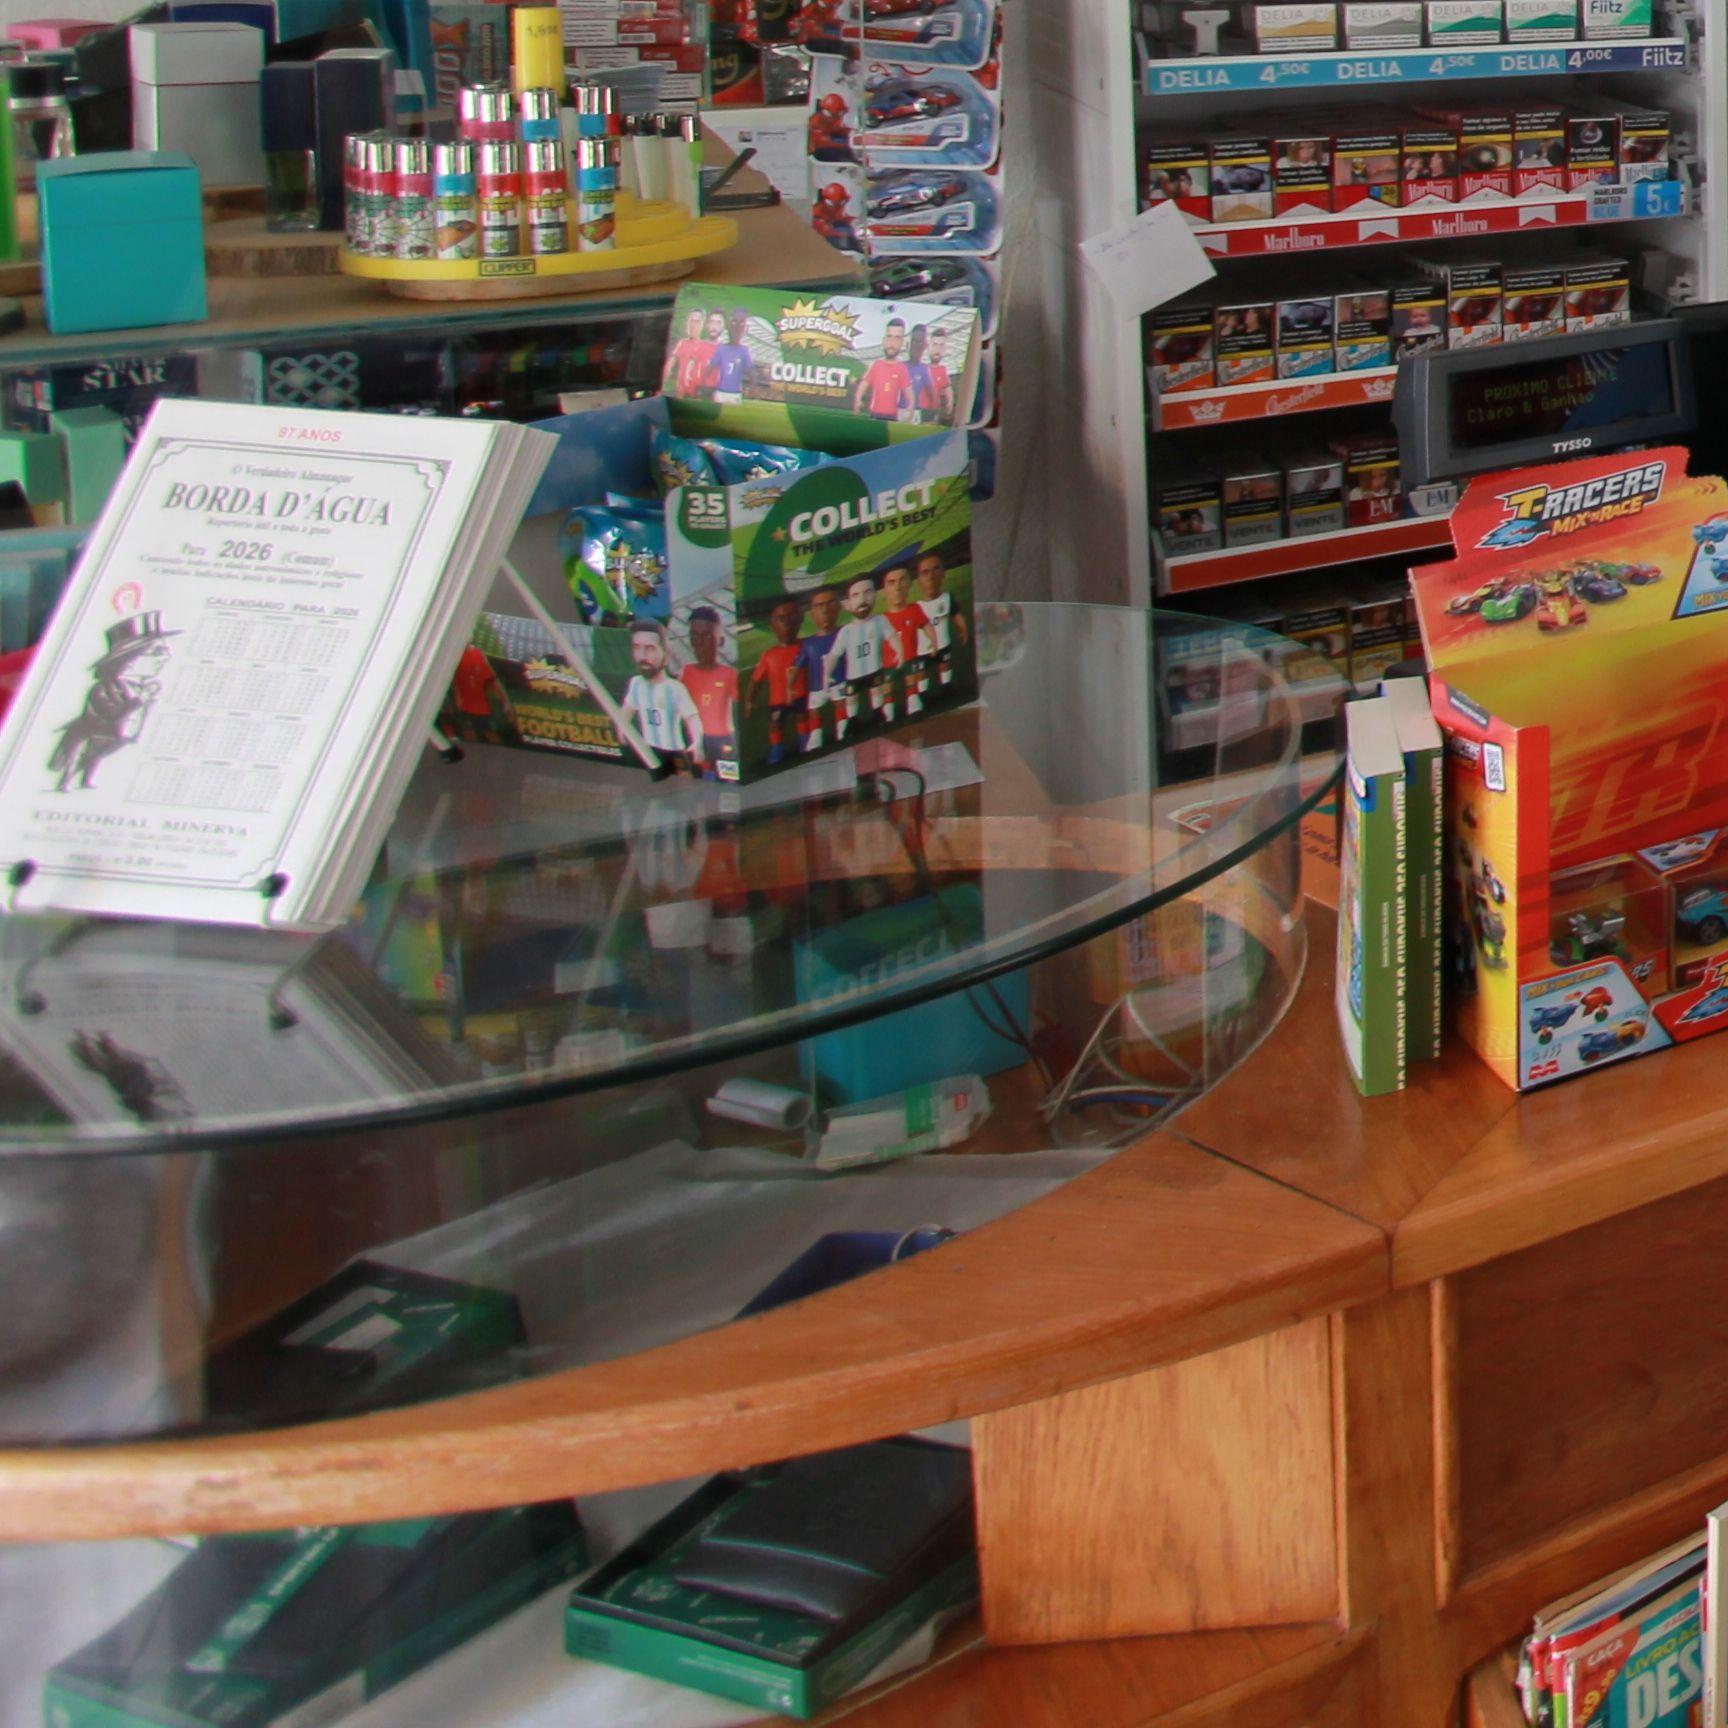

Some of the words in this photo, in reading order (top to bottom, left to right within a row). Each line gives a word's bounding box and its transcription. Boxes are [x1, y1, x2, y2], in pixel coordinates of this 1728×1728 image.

[1161, 70, 1230, 89] DELIA
[1337, 61, 1402, 80] DELIA
[1502, 53, 1560, 72] DELIA
[1642, 47, 1684, 68] Fiitz
[1264, 225, 1324, 251] Marlboro
[1432, 213, 1488, 238] Marlboro
[780, 314, 855, 343] SUPERGOAL
[770, 361, 851, 389] COLLECT
[300, 426, 343, 442] ANOS
[1552, 437, 1592, 454] TYSSO
[163, 481, 268, 518] BORDA
[274, 479, 395, 527] D'ÁGUA
[687, 490, 726, 516] 35
[790, 479, 936, 543] COLLECT
[792, 539, 825, 557] THE
[827, 518, 900, 551] WORLD'S
[902, 506, 938, 526] BEST
[219, 538, 272, 562] 2026
[517, 718, 618, 747] FOOTBALL
